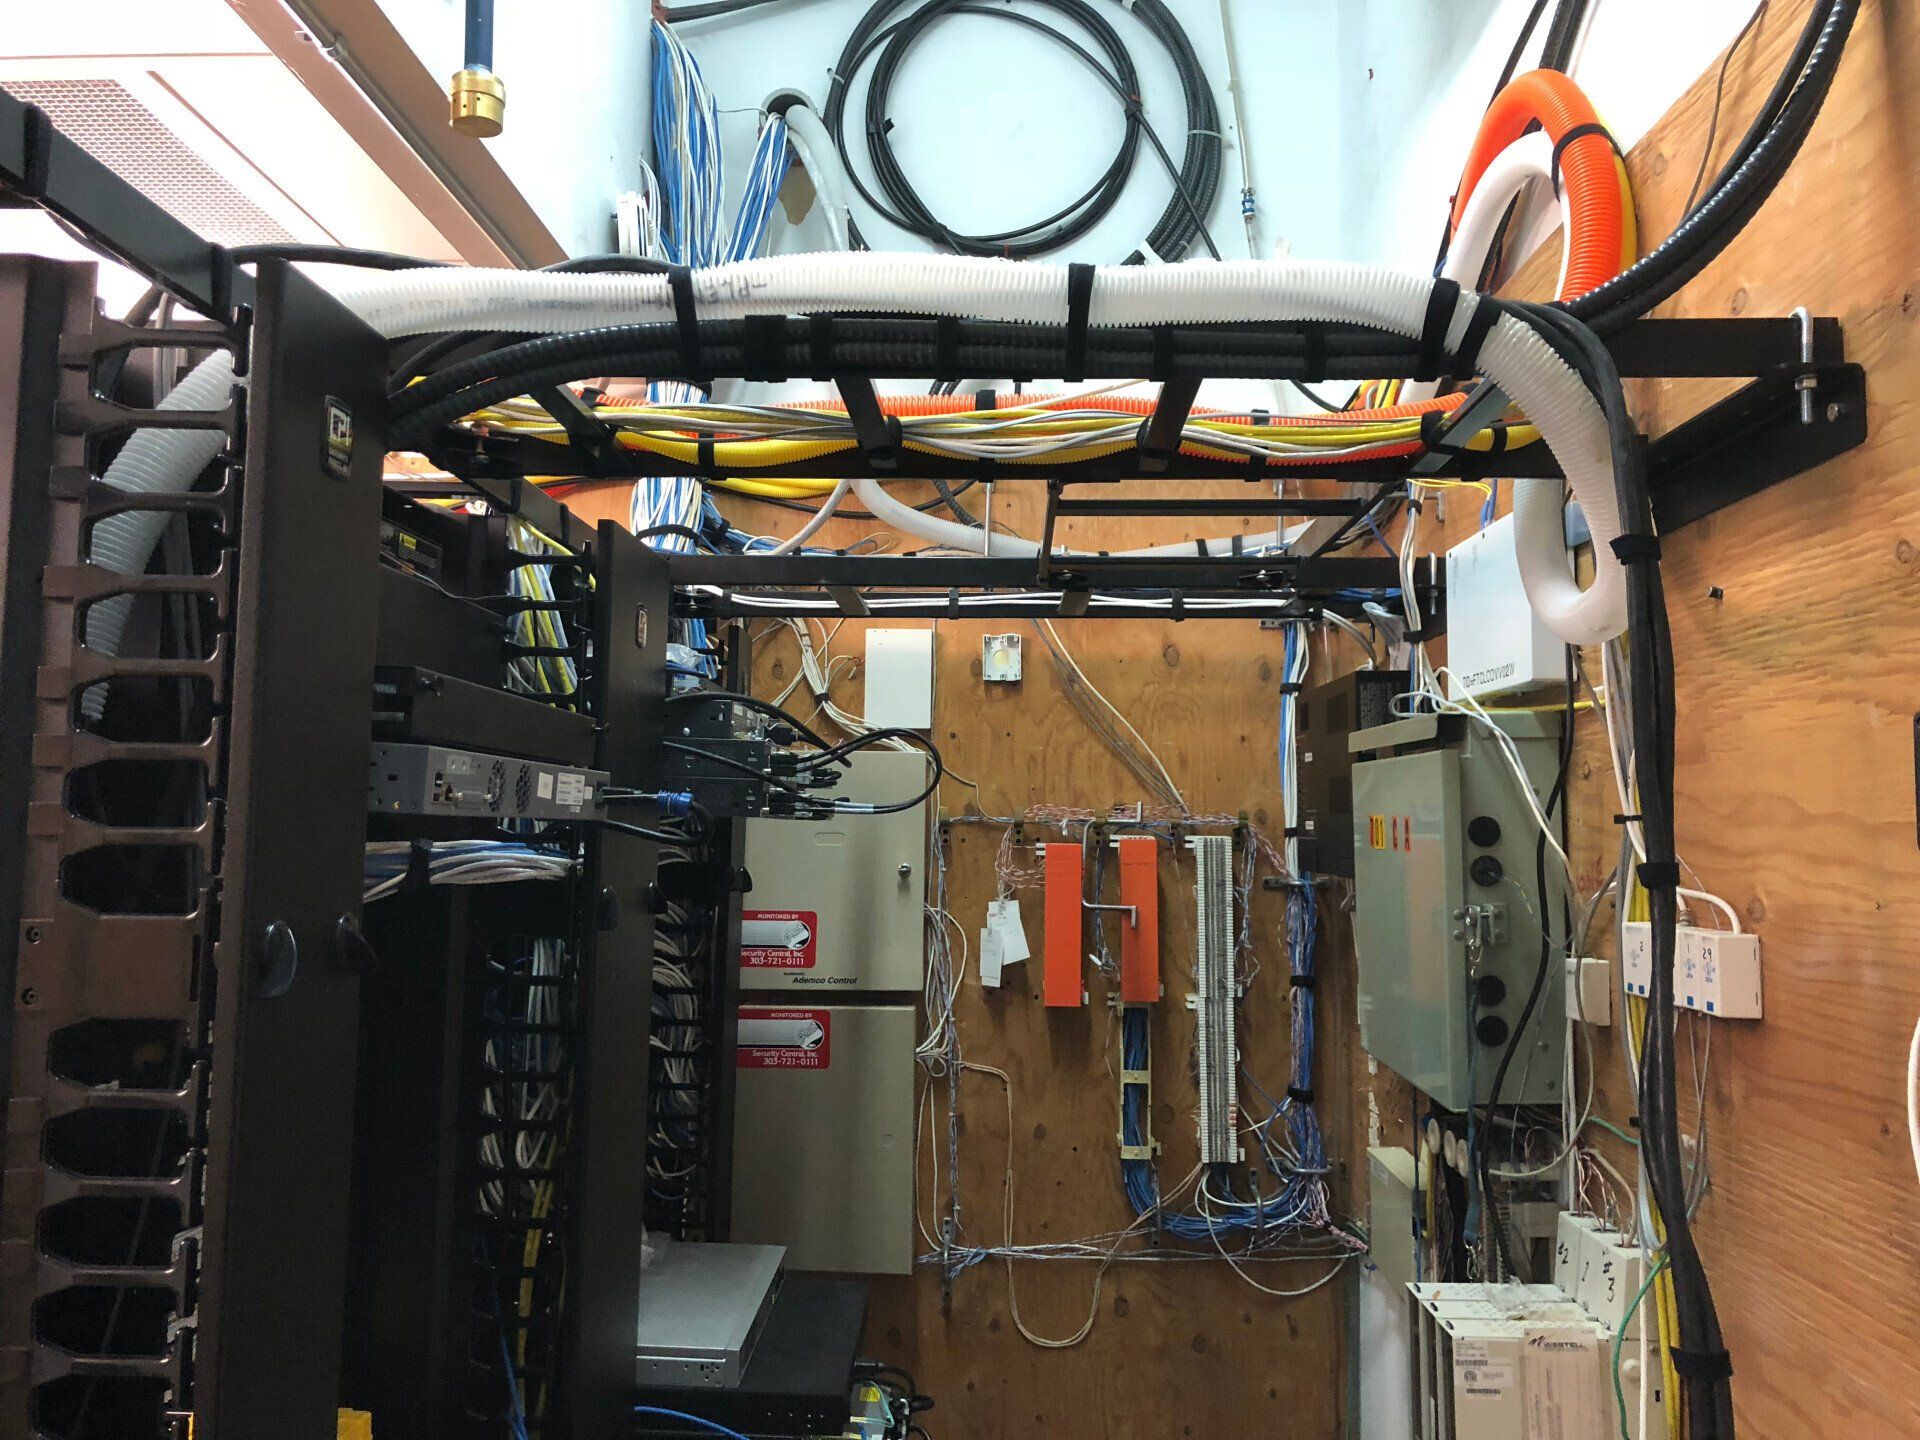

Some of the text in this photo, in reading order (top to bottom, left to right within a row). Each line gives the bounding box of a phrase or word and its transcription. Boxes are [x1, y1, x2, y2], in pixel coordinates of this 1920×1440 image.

[741, 950, 766, 958] Security
[750, 957, 804, 965] 303-721-0111
[792, 976, 858, 984] Ademco Control
[752, 1050, 779, 1059] Security
[763, 1057, 819, 1066] 303-721-0111
